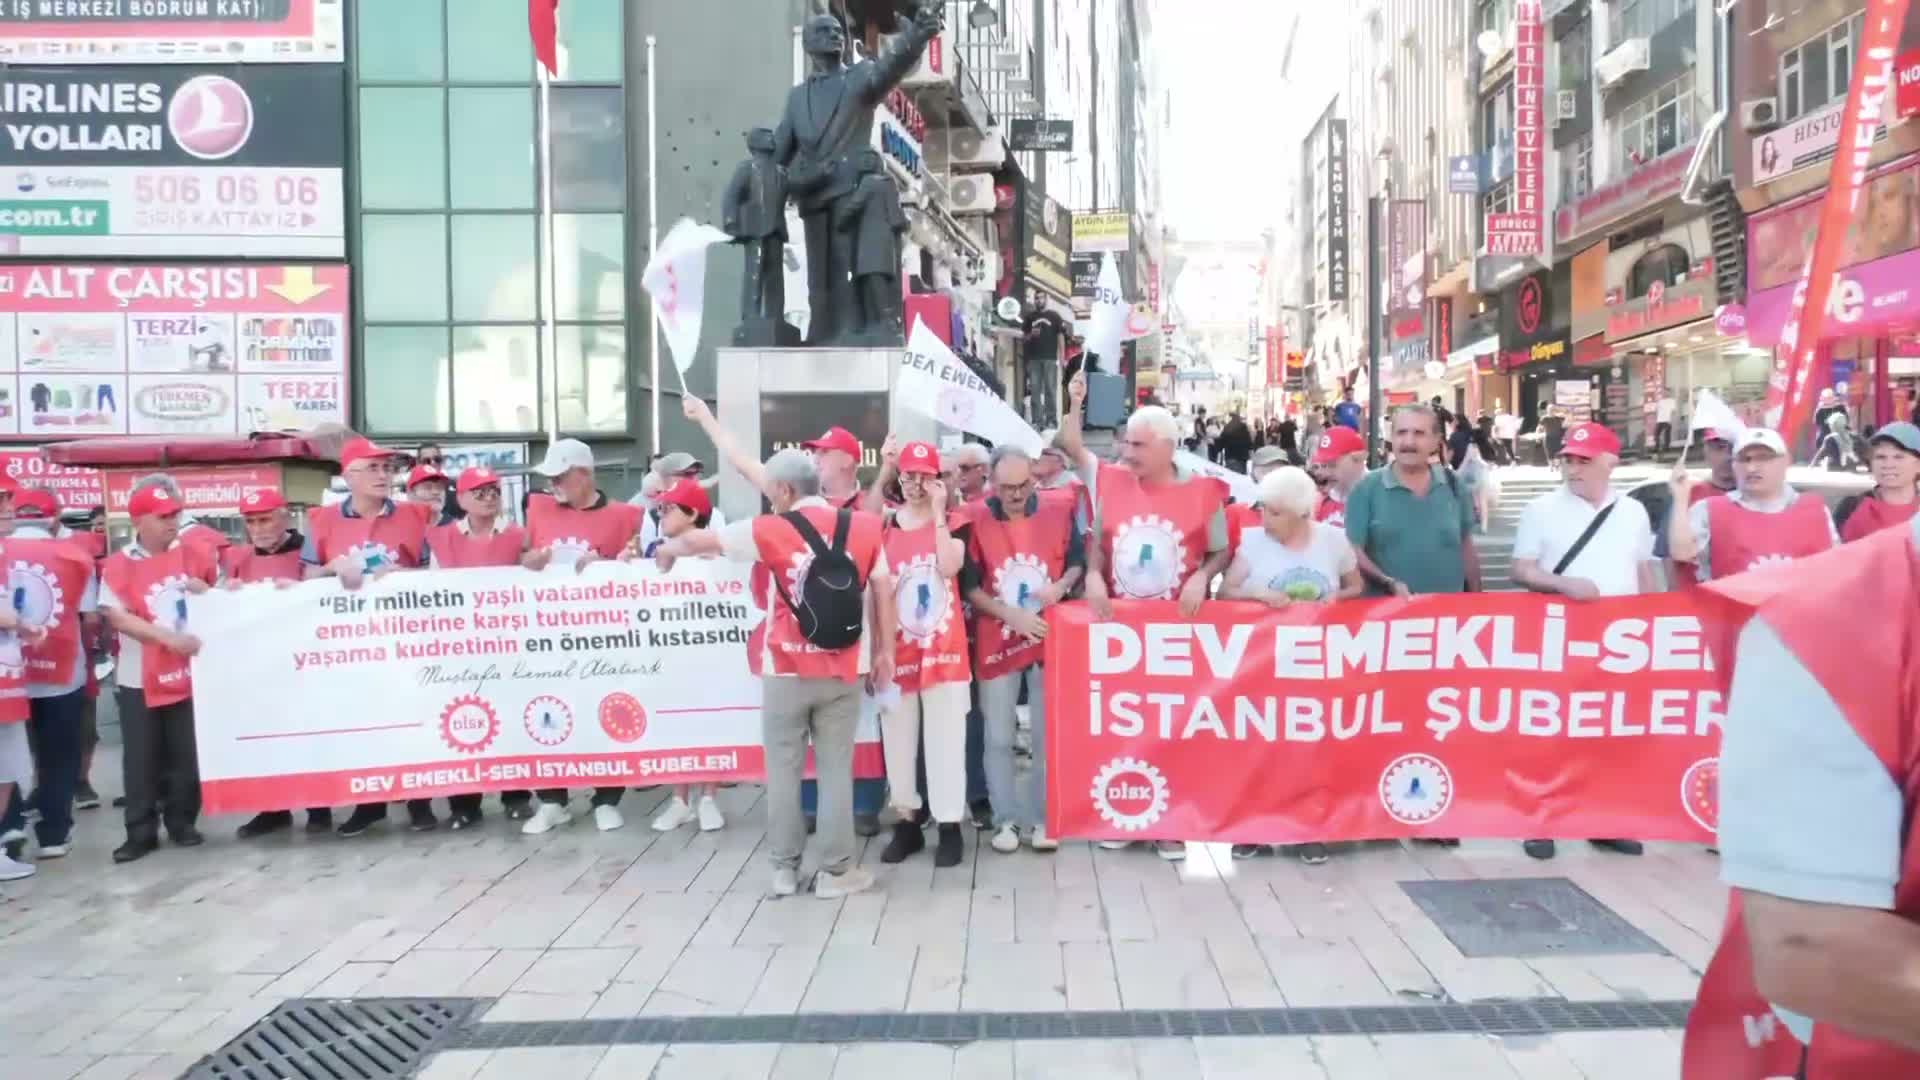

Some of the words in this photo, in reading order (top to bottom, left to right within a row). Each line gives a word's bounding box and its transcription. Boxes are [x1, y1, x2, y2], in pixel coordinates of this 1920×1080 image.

[130, 1, 207, 16] BODRUM
[0, 83, 162, 113] IRLINES
[6, 124, 162, 151] YOLLARI
[135, 176, 201, 204] 506
[217, 176, 258, 205] 06
[275, 176, 318, 206] 06
[24, 267, 95, 299] ALT
[107, 267, 257, 307] ÇARŞISI
[131, 314, 197, 336] TERZİ
[263, 377, 337, 400] TERZİ
[375, 590, 465, 612] milletin
[473, 584, 525, 610] yaşlı
[533, 578, 707, 603] vatandaşlarına
[715, 580, 743, 594] ve
[316, 614, 465, 640] emeklilerine
[474, 610, 529, 631] karşı
[536, 609, 631, 627] tutumu;
[637, 609, 651, 623] o
[660, 601, 748, 622] milletin
[294, 647, 387, 670] yaşama
[395, 637, 519, 660] kudretinin
[525, 637, 552, 652] en
[560, 630, 641, 651] önemli
[1088, 622, 1255, 680] DEV
[1274, 603, 1716, 681] EMEKLİ-SE
[419, 663, 502, 694] Mustafa
[511, 660, 578, 680] Kemal
[1088, 680, 1403, 742] İSTANBUL
[1425, 686, 1728, 742] ŞUBELER
[350, 774, 395, 793] DEV
[402, 759, 530, 790] EMEKLİ-SEN
[536, 757, 634, 778] İSTANBUL
[640, 752, 738, 776] ŞUBELERİ
[1108, 781, 1152, 801] DİSK
